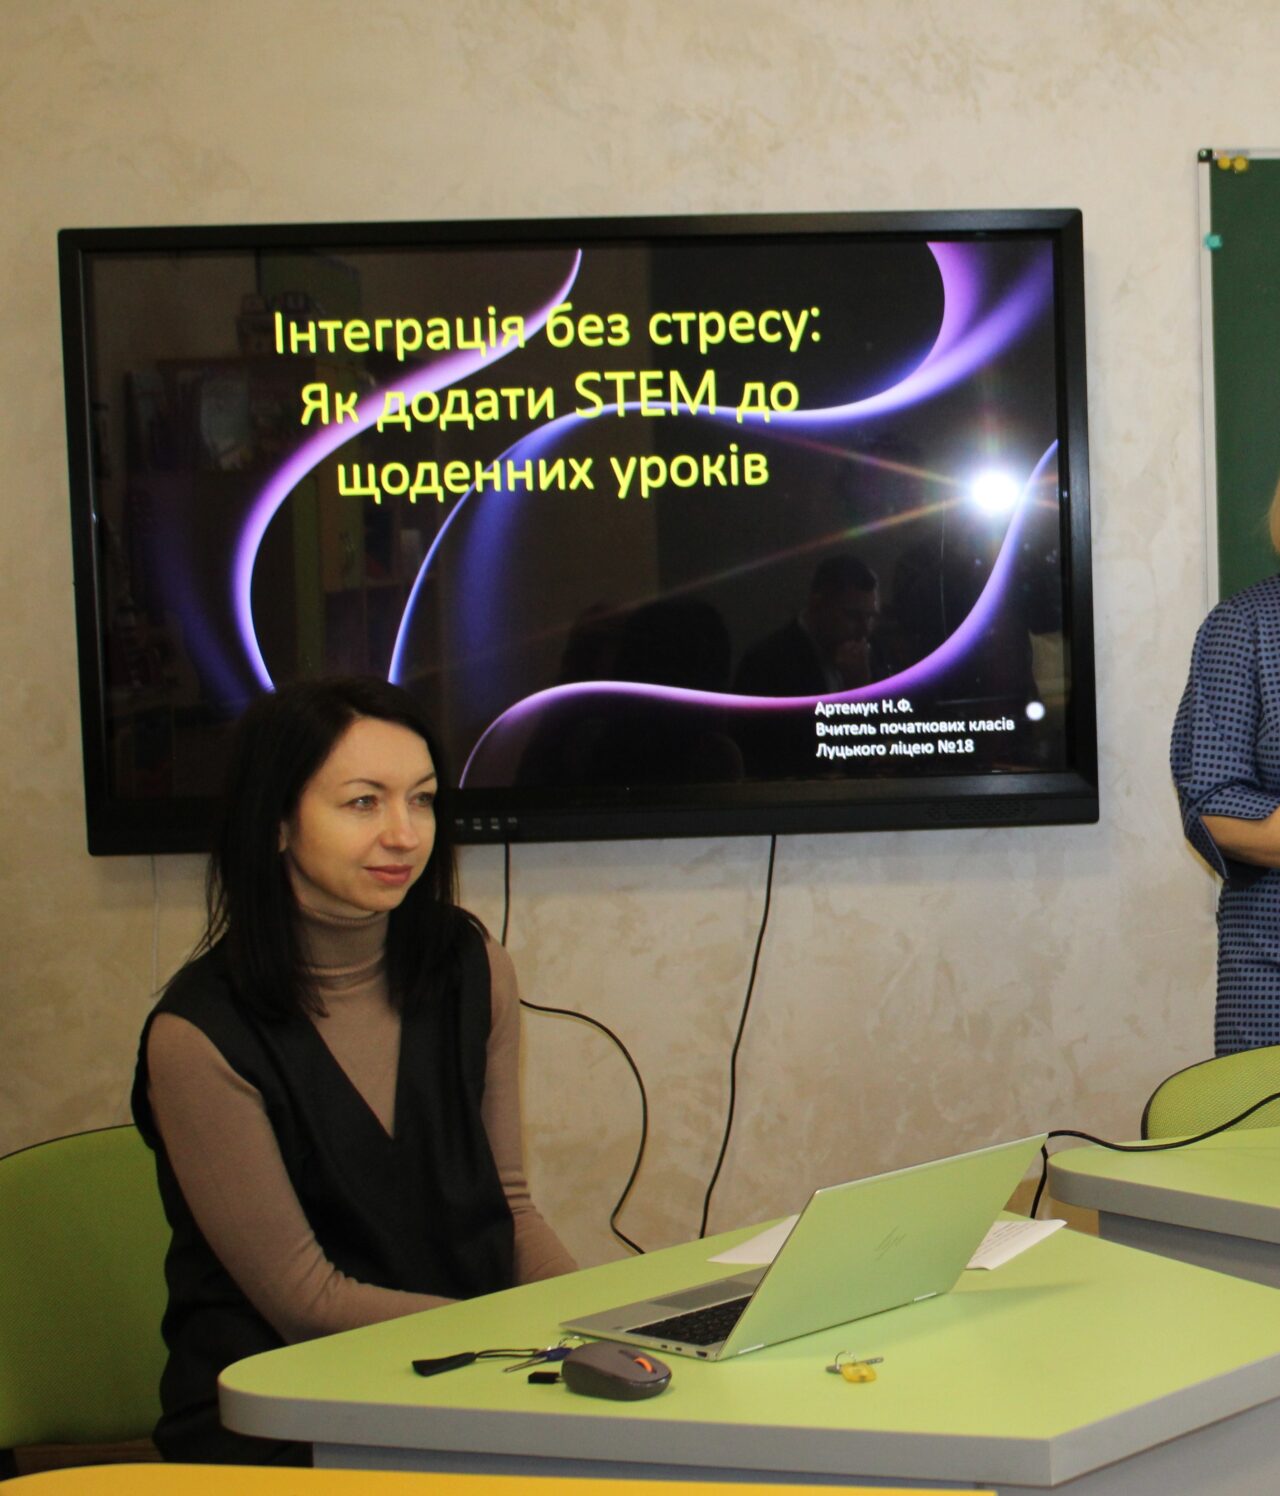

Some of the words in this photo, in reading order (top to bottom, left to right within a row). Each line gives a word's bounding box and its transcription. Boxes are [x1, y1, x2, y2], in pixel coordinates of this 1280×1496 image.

[274, 305, 526, 362] Інтеграція
[545, 301, 630, 348] без
[648, 306, 821, 355] стресу:
[300, 382, 359, 426] Як
[376, 386, 555, 433] додати
[574, 369, 717, 418] STEM
[735, 380, 799, 423] до
[337, 456, 594, 505] щоденних
[609, 443, 769, 499] уроків
[815, 700, 879, 718] Артемук
[881, 698, 913, 714] Н.Ф.
[815, 721, 877, 737] Вчитель
[879, 720, 966, 735] початкових
[968, 716, 1015, 732] класів
[815, 742, 887, 760] Луцького
[889, 739, 935, 758] ліцею
[937, 738, 975, 754] №18
